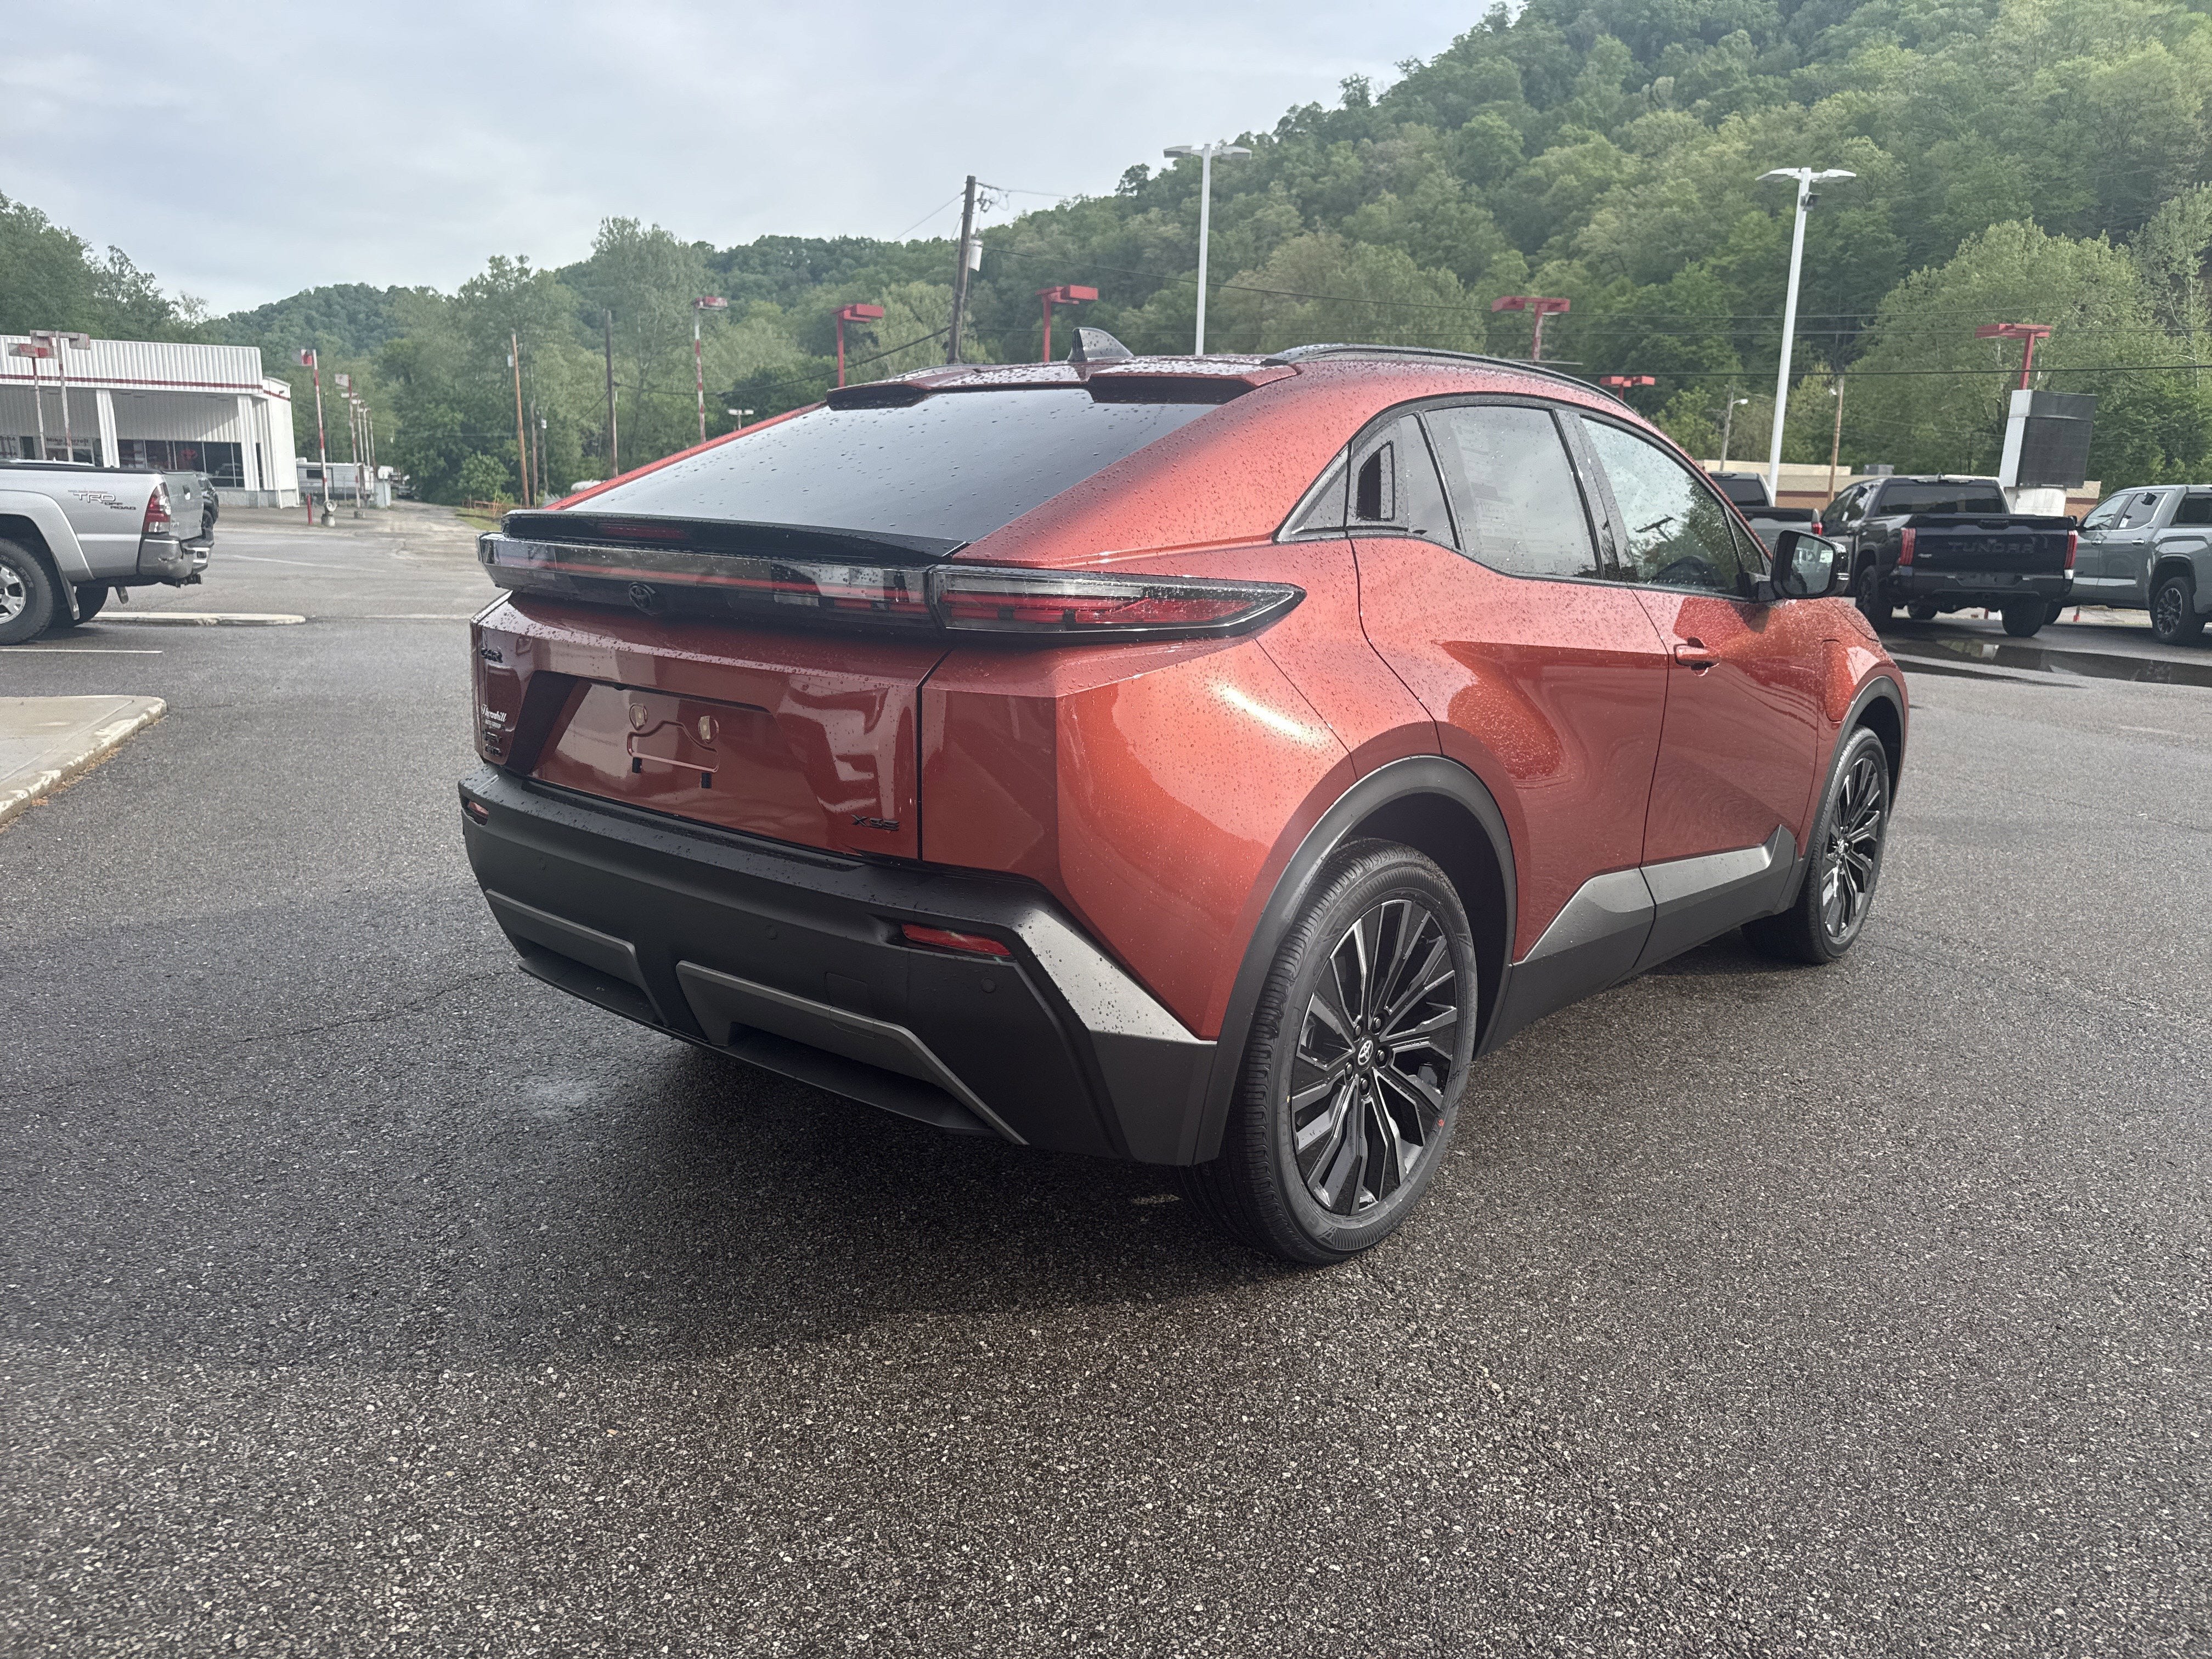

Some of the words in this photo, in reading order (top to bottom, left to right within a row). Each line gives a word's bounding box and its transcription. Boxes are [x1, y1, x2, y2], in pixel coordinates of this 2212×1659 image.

[74, 493, 116, 503] TRD
[1948, 542, 2035, 554] TUNDRA
[482, 704, 507, 722] Thornhill
[851, 814, 900, 832] XSE
